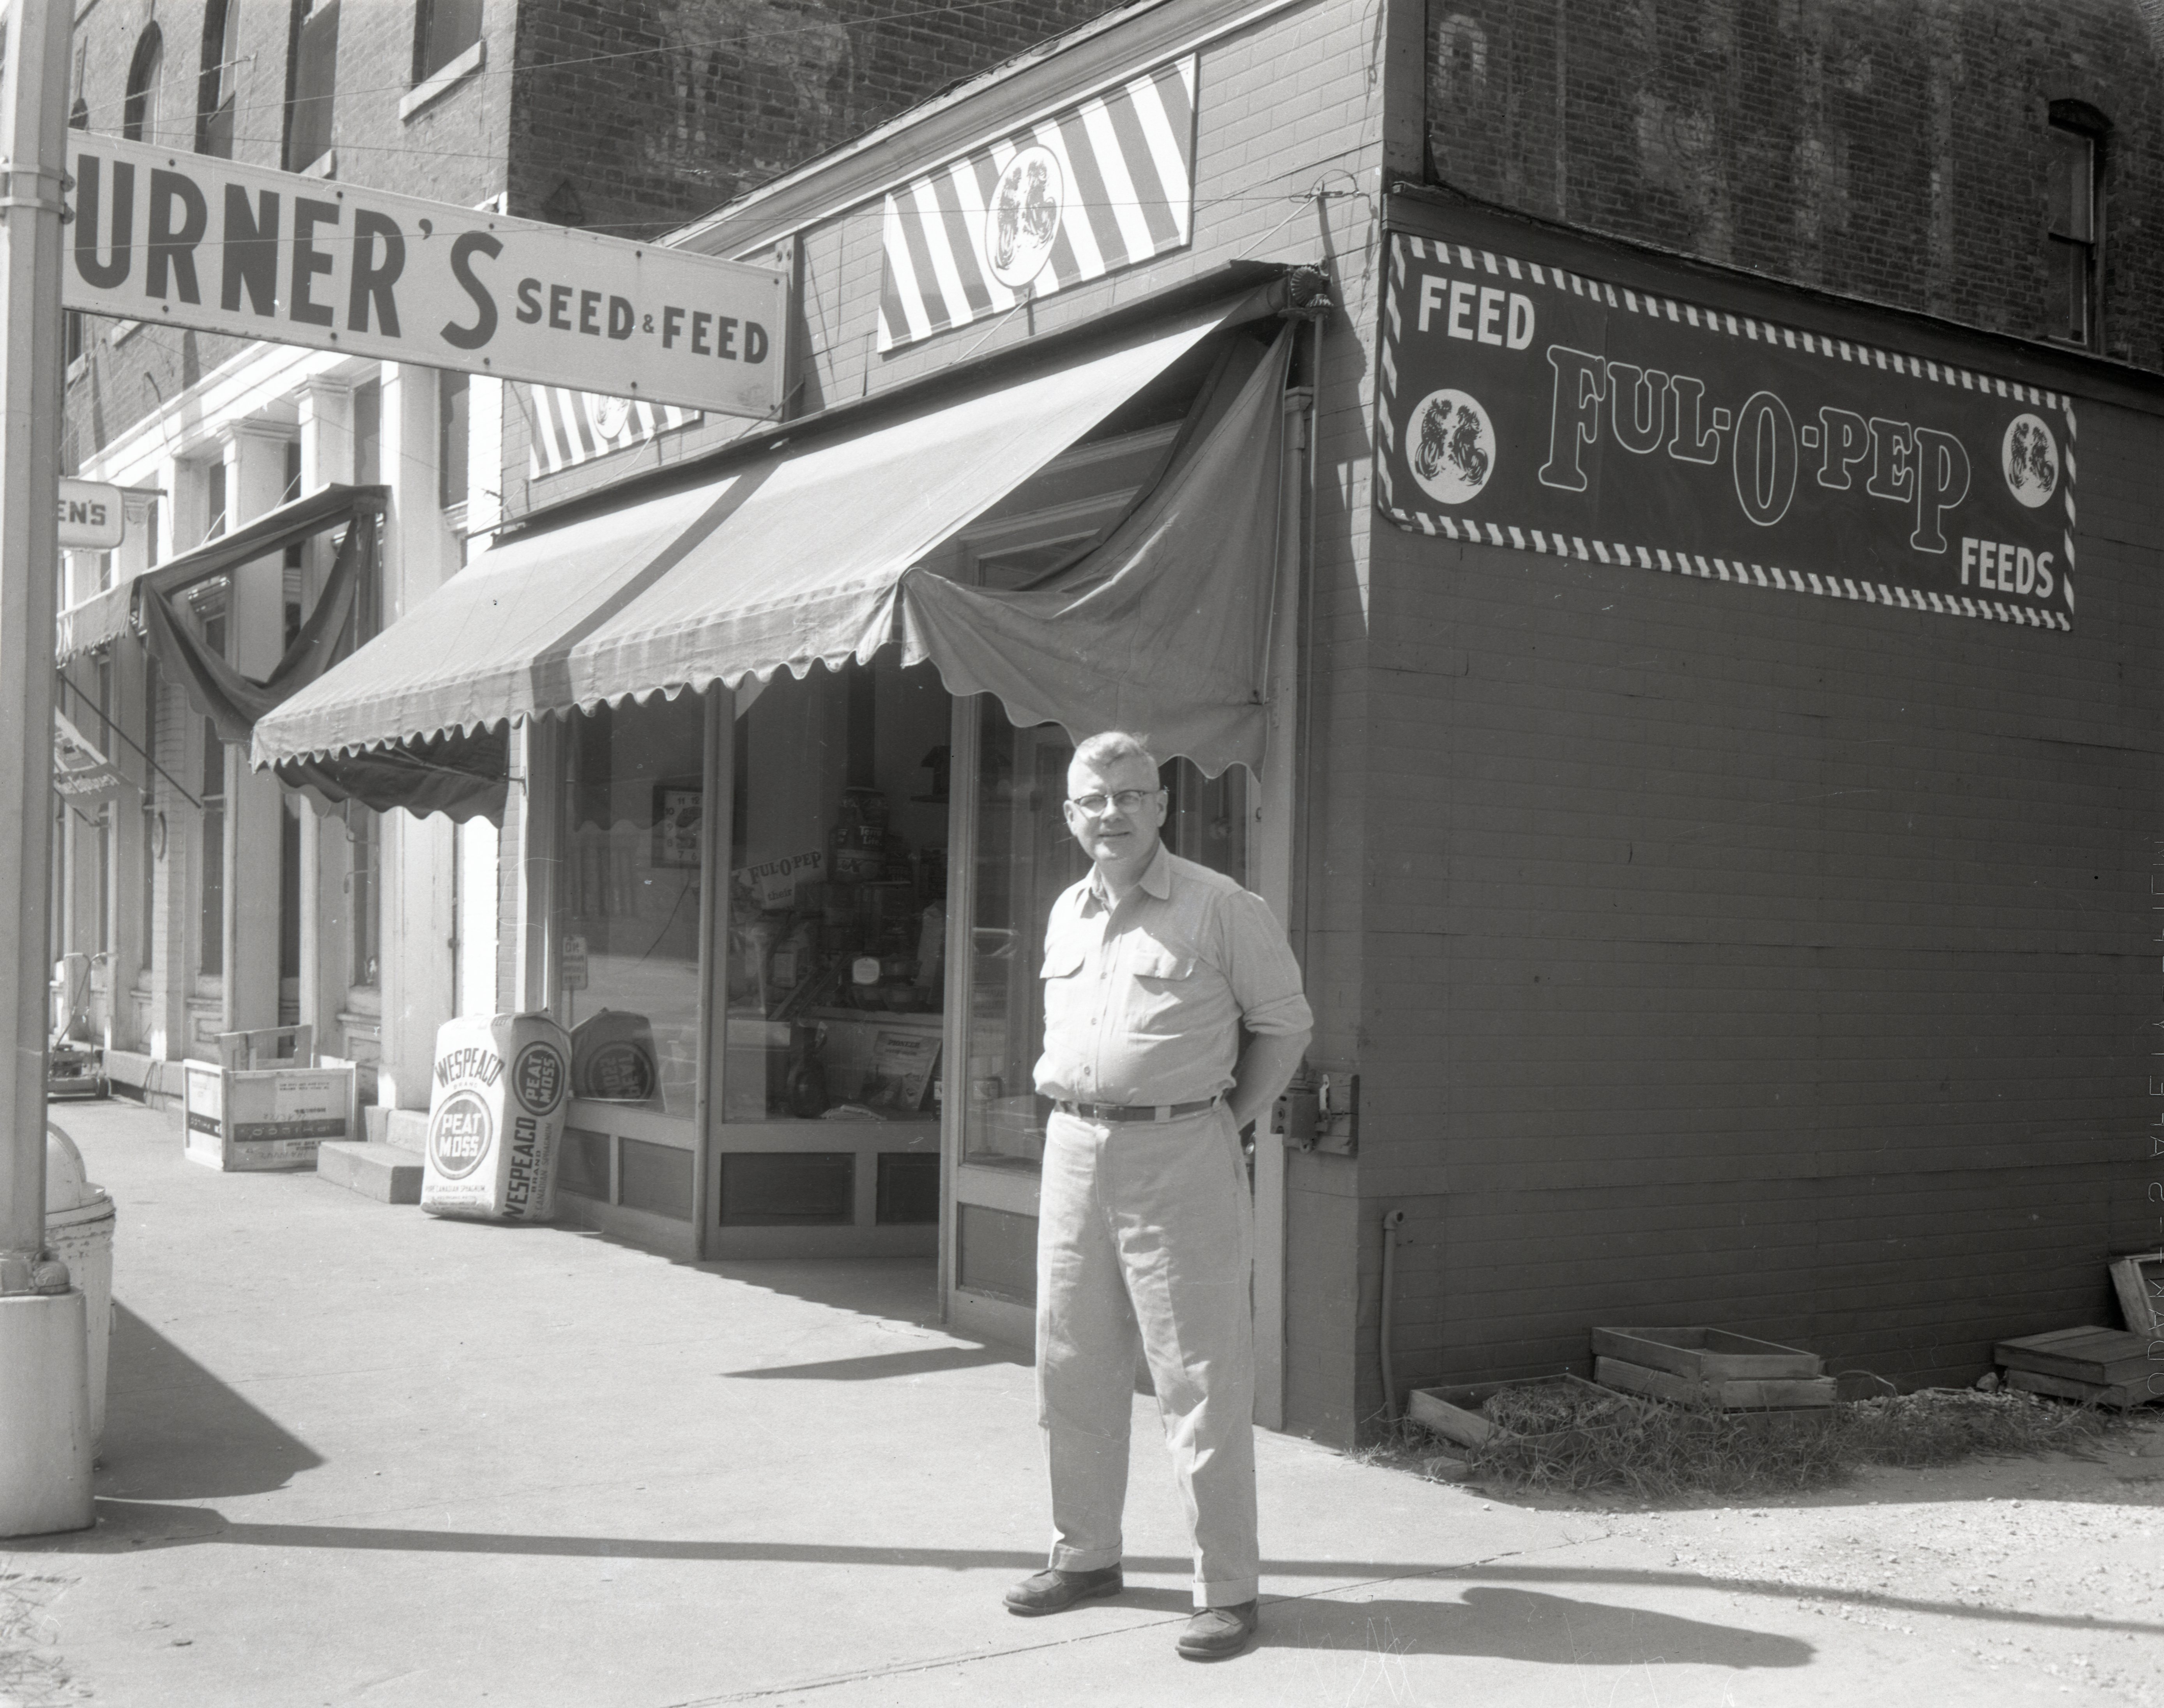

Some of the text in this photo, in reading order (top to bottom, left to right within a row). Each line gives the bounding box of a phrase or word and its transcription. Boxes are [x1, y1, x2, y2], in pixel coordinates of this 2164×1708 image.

[516, 277, 635, 341] SEED
[642, 313, 655, 334] &
[662, 305, 769, 365] FEED
[1418, 274, 1535, 350] FEED
[1539, 344, 1970, 553] FUL-O-PEP
[1961, 537, 2054, 598] FEEDS
[691, 796, 700, 804] 12
[767, 888, 792, 901] their
[435, 1047, 506, 1088] WESPEACO
[526, 1054, 542, 1102] PEAT
[539, 1057, 555, 1104] MOSS
[439, 1136, 479, 1158] MOSS
[442, 1113, 482, 1135] PEAT
[502, 1116, 537, 1220] WESPEACO
[532, 1151, 541, 1193] BRAND
